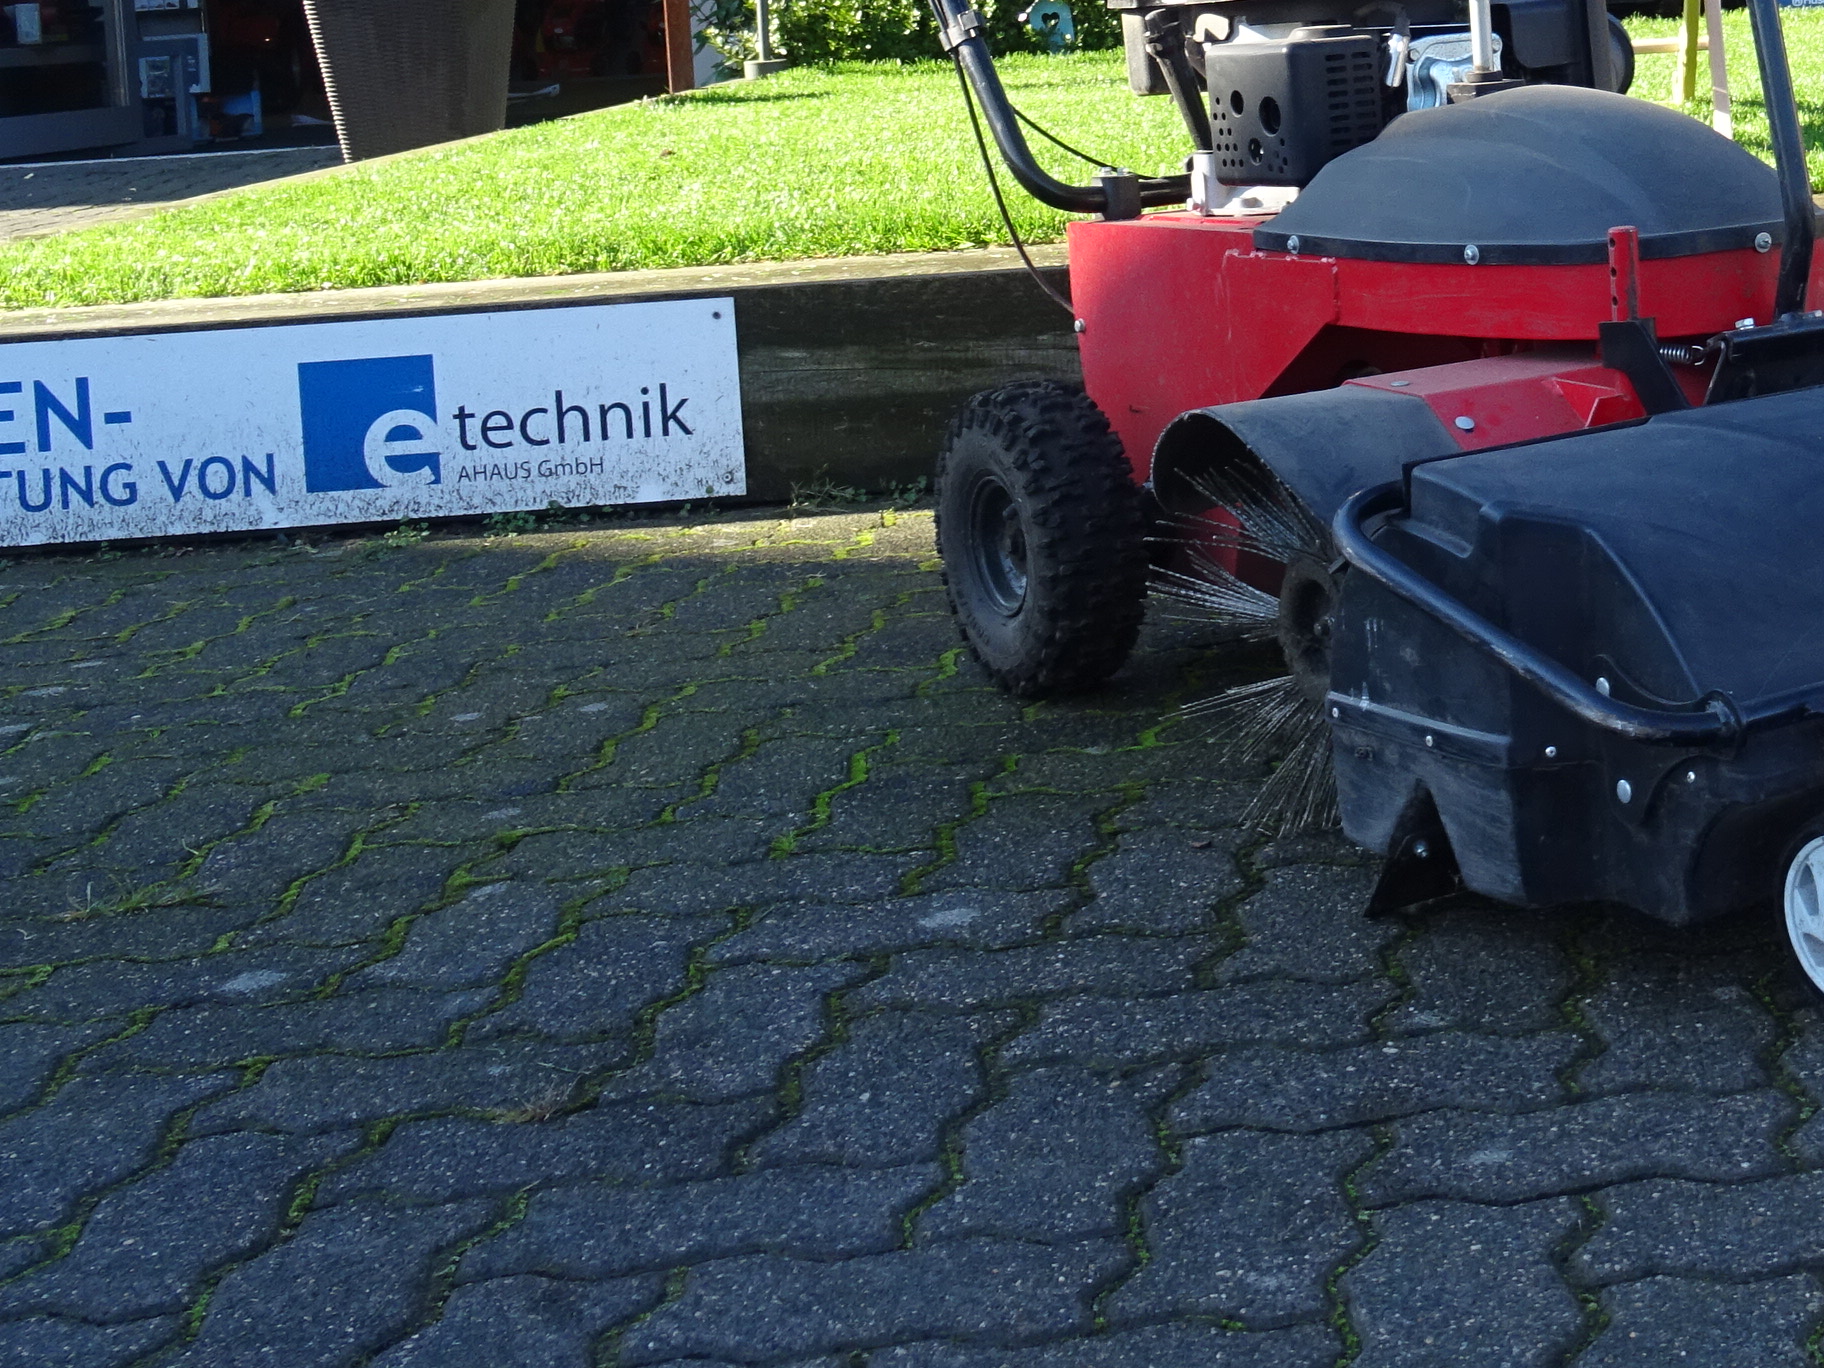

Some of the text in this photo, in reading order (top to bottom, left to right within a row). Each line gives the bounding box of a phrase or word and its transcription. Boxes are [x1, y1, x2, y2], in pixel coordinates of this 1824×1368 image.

[452, 382, 694, 451] technik
[157, 452, 277, 502] VON
[458, 455, 606, 484] AHAUS GmbH
